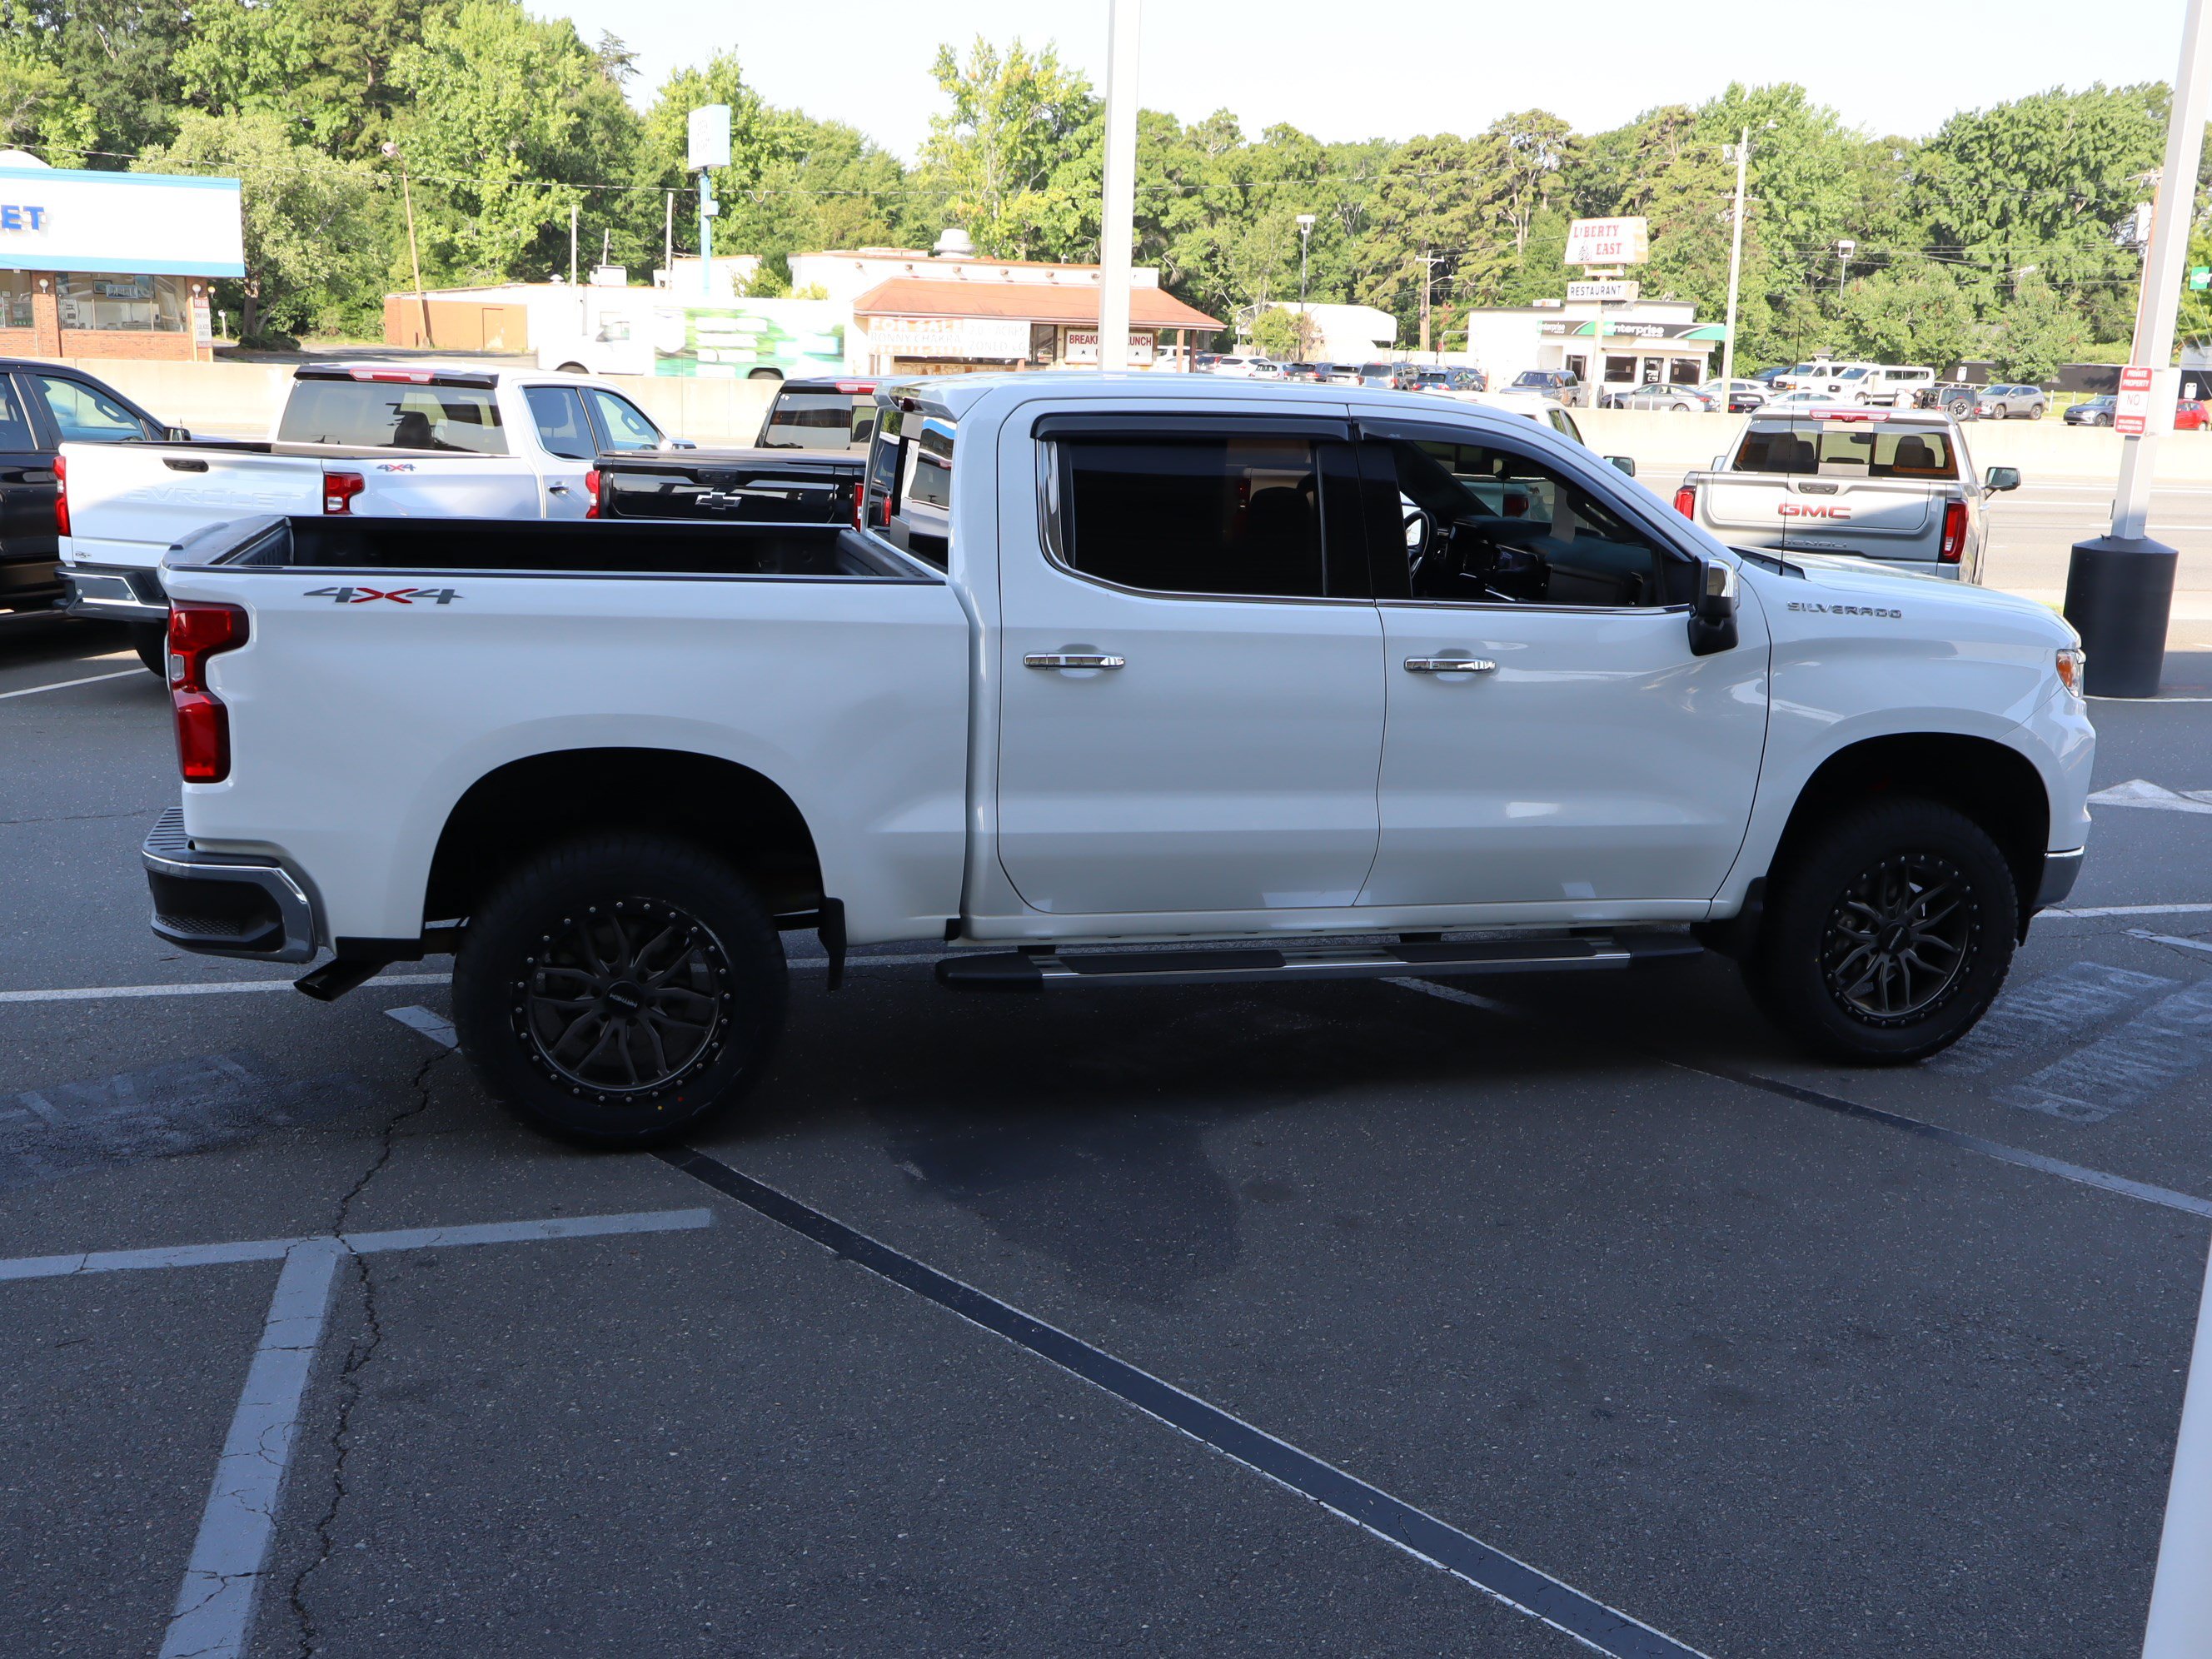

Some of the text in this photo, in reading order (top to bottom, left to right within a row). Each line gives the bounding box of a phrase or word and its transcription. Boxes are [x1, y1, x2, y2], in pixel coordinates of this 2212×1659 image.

[1, 205, 44, 231] ET
[1573, 224, 1620, 239] LIBERTY
[1596, 242, 1622, 255] EAST
[1570, 285, 1622, 296] RESTAURANT
[870, 317, 963, 333] FOR SALE
[1604, 324, 1665, 336] enterprise
[1069, 334, 1099, 345] BREAK
[2122, 379, 2150, 387] PROPERTY
[2127, 394, 2140, 406] NO
[120, 486, 306, 510] EVROLET
[1777, 502, 1851, 520] GMC
[1780, 540, 1847, 549] DENALI
[1786, 600, 1902, 619] SILVERADO
